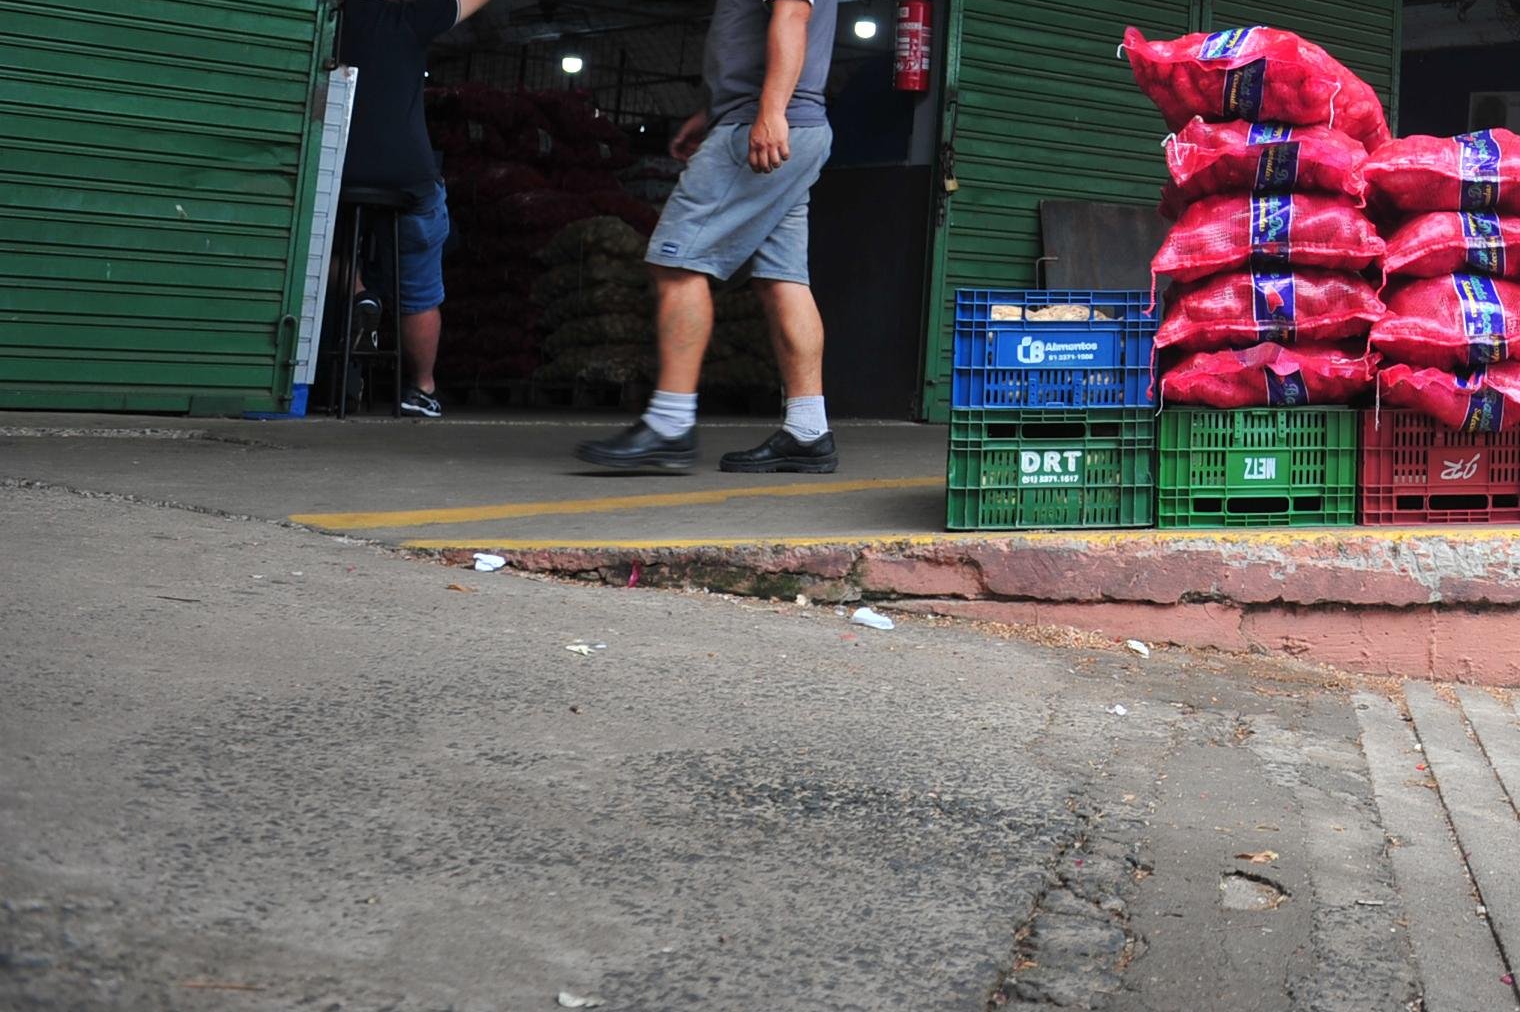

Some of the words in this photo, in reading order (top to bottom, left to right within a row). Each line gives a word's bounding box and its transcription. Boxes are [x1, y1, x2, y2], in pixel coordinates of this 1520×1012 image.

[1045, 341, 1098, 352] Alimentos
[1021, 451, 1083, 473] DRT
[1243, 457, 1276, 480] METZ
[1440, 452, 1481, 480] JR
